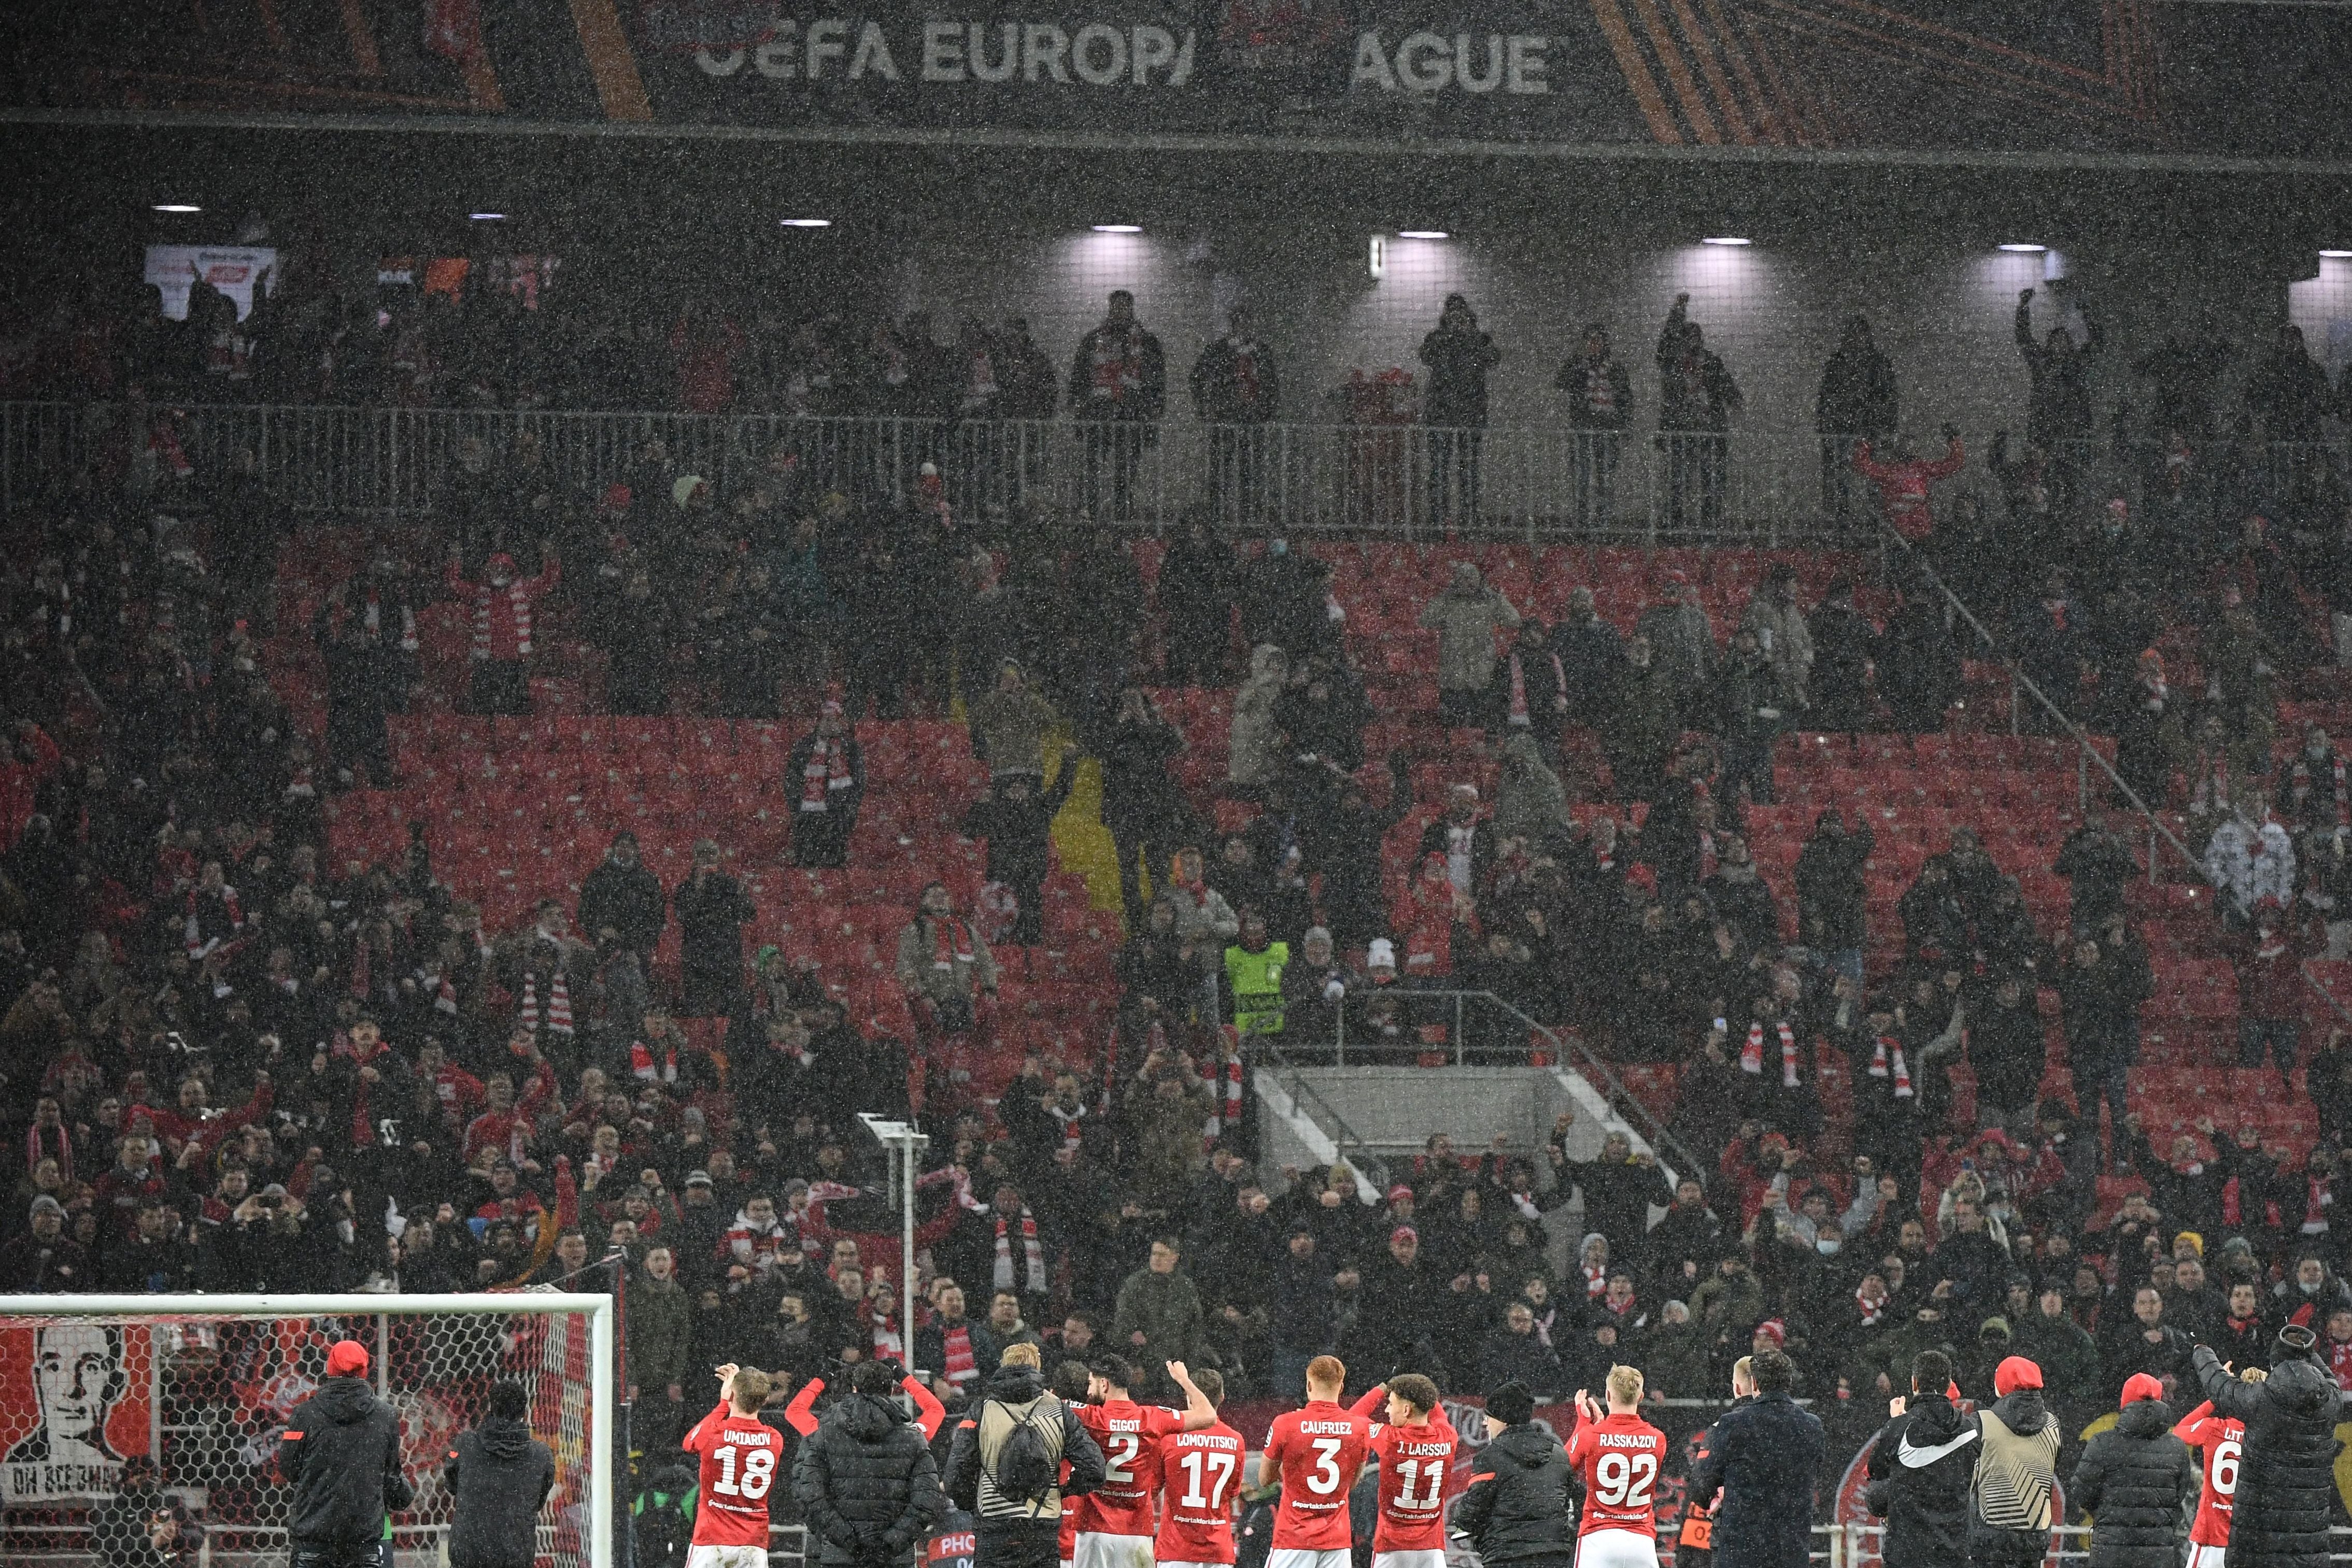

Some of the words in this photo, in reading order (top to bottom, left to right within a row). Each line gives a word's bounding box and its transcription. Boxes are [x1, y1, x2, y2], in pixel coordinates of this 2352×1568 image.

[724, 1429, 771, 1446] UMIAROV
[1110, 1419, 1141, 1432] GIGOT
[1177, 1433, 1238, 1451] LOMOVITSKIY
[1300, 1420, 1352, 1435] CAUFRIEZ
[1397, 1441, 1406, 1455] J.
[1408, 1442, 1451, 1457] LARSSON
[1599, 1433, 1657, 1448] RASSKAZOV
[713, 1445, 775, 1500] 18
[1106, 1432, 1139, 1483] 2
[1181, 1451, 1236, 1509] 17
[1306, 1437, 1342, 1494] 3
[1595, 1452, 1657, 1507] 92
[2211, 1441, 2242, 1494] 6
[1393, 1459, 1444, 1509] 11
